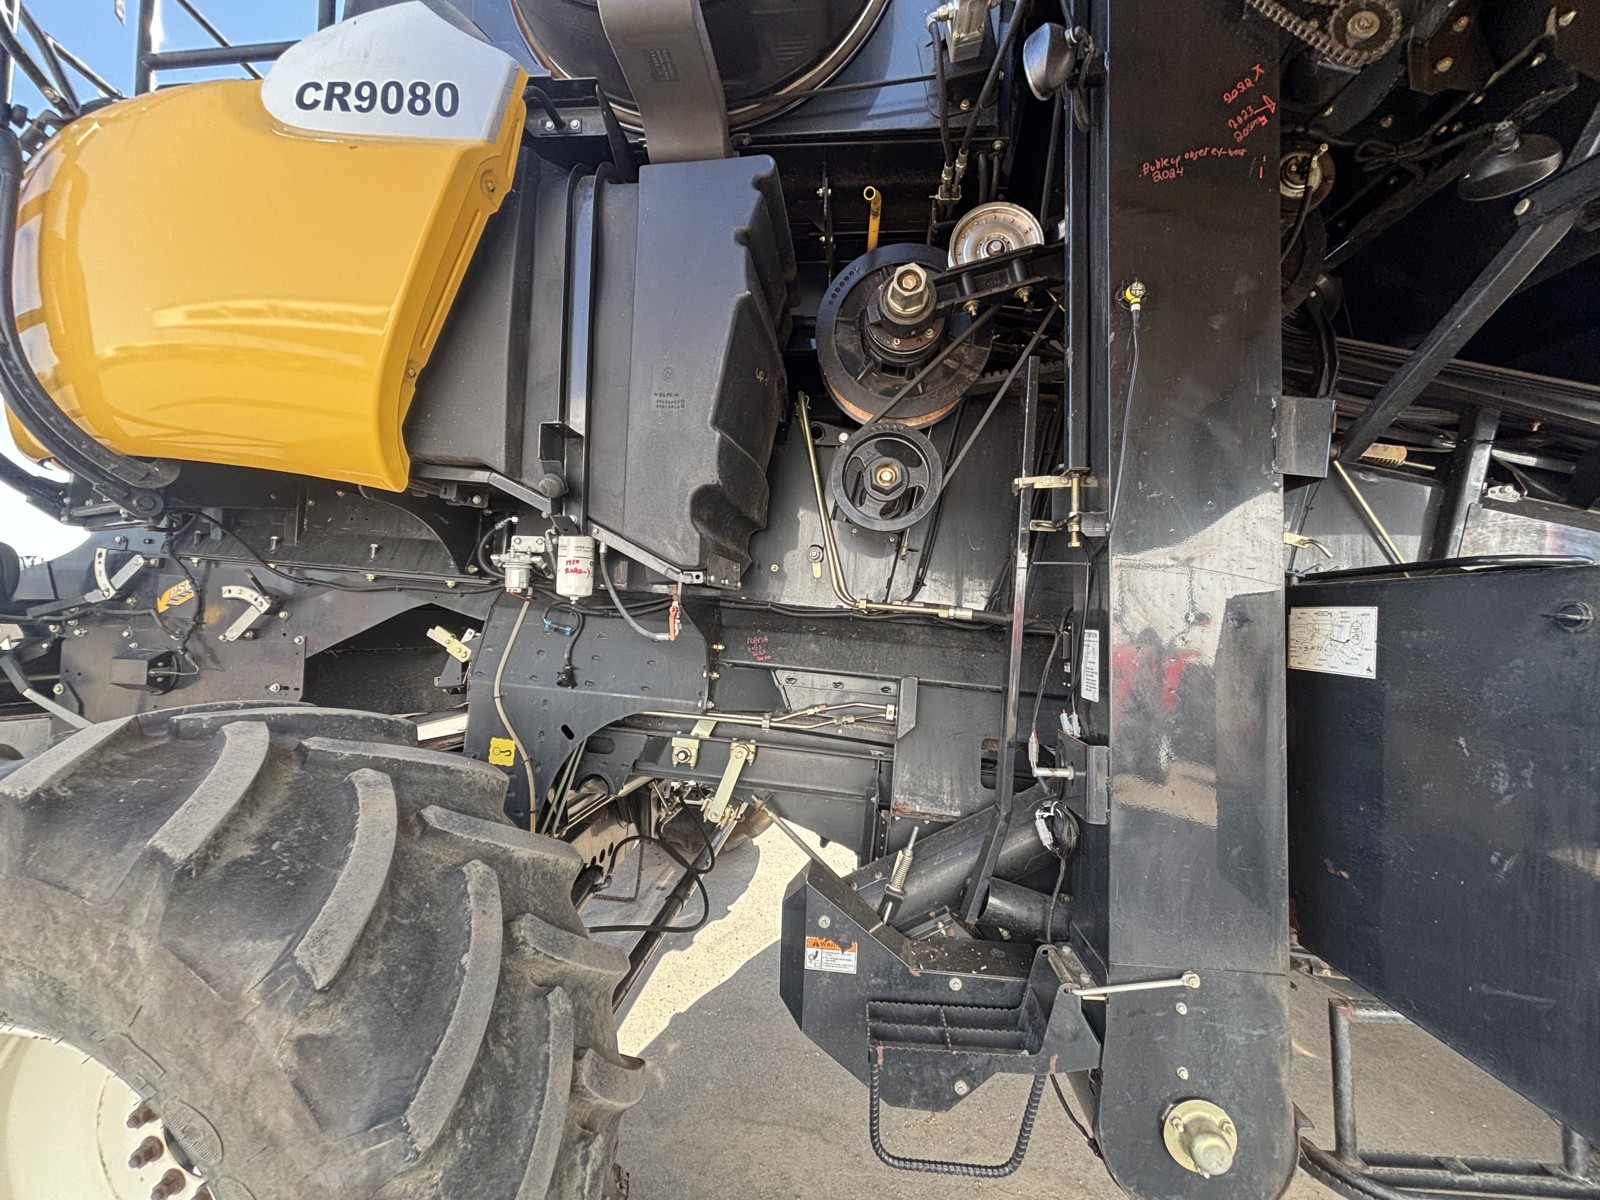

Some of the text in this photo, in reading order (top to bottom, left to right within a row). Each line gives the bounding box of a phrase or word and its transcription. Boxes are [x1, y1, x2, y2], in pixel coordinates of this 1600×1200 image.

[295, 81, 459, 118] CR9080
[1228, 105, 1254, 129] 2023
[1152, 166, 1184, 183] 2024
